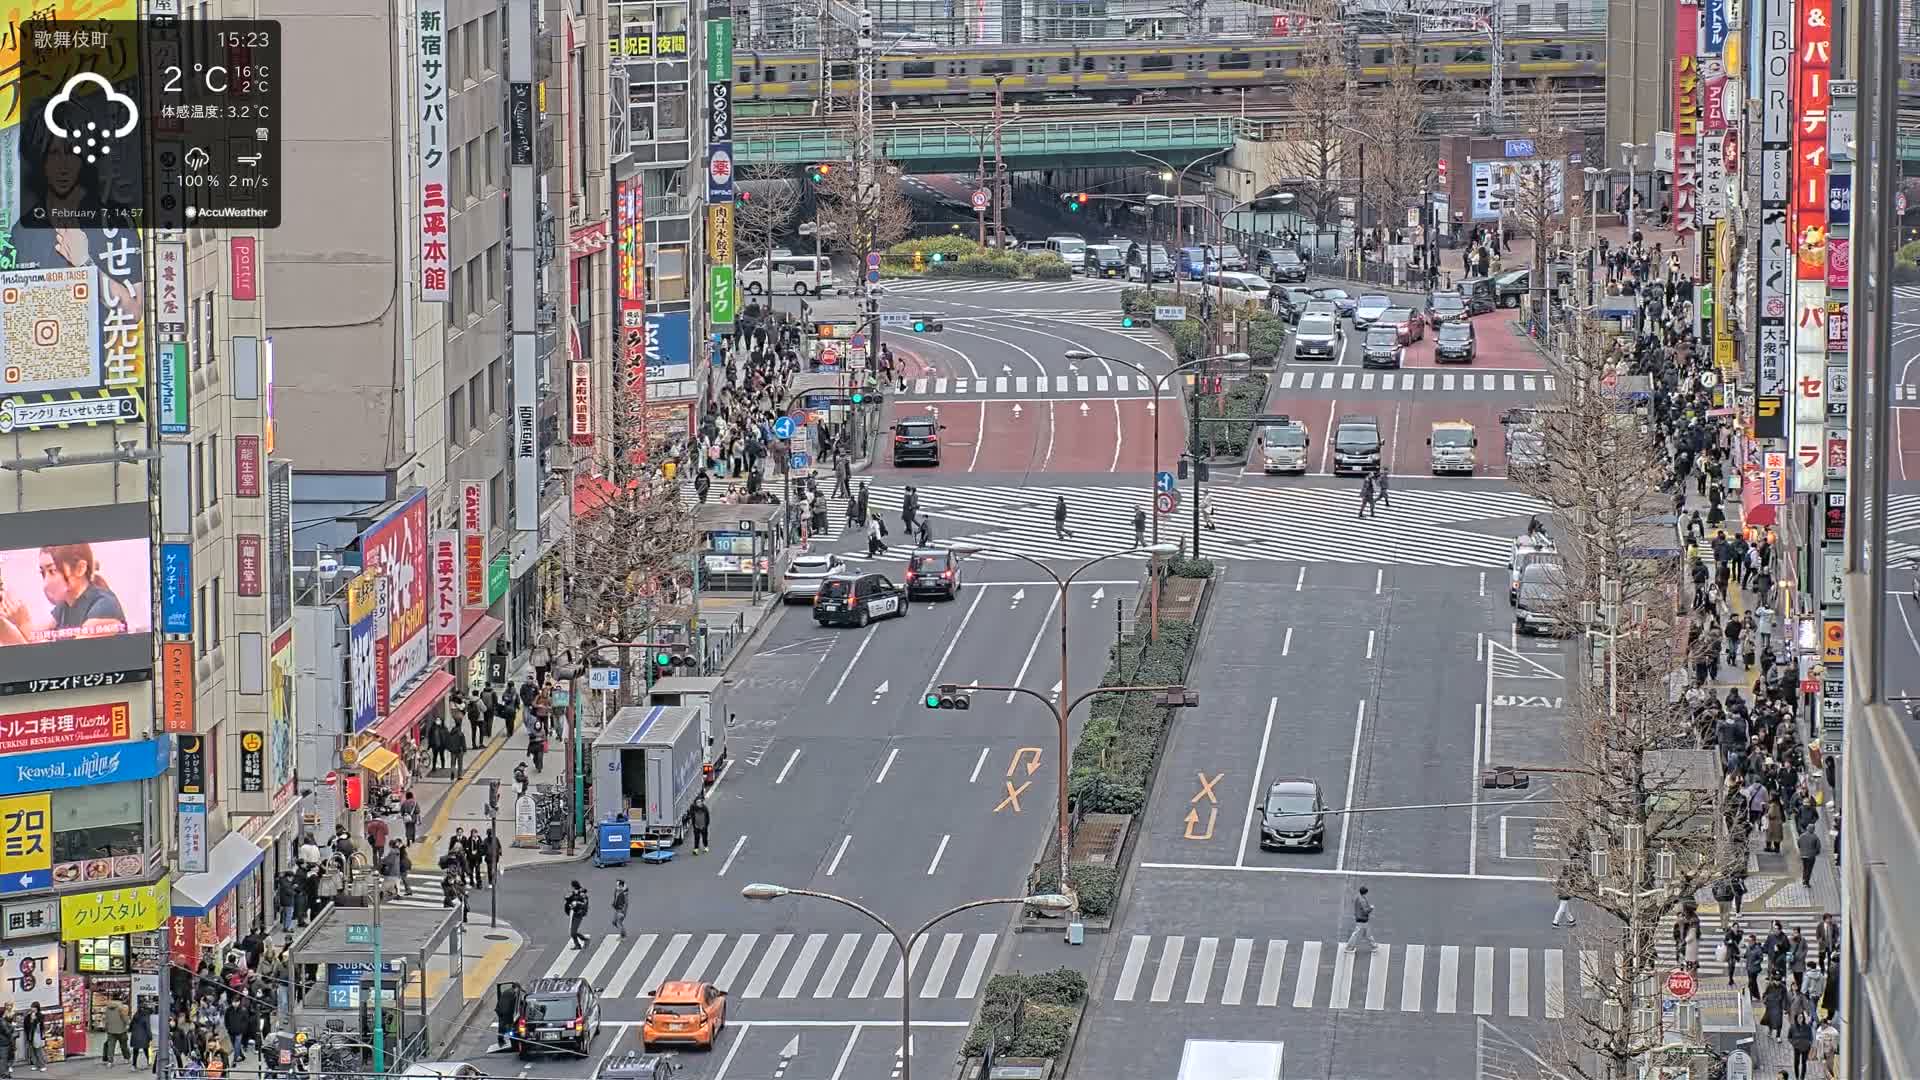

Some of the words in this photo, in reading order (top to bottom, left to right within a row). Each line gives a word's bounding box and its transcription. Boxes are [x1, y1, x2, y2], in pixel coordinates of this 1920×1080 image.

[624, 36, 652, 54] 祝日
[657, 35, 685, 53] 夜間
[421, 10, 443, 169] 新宿サンパーク
[1680, 56, 1696, 135] パチンコ
[713, 84, 728, 137] もつなべ
[1709, 86, 1721, 119] アコム
[712, 160, 730, 176] 薬
[1679, 145, 1696, 232] エスパス
[424, 184, 446, 290] 三平本館
[714, 206, 729, 261] 肉汁水餃子
[1, 273, 45, 285] Instagram
[715, 275, 728, 311] レイク
[163, 323, 181, 333] 3F
[1763, 329, 1776, 381] 大衆酒場
[162, 353, 174, 412] FamilyMart
[1799, 307, 1825, 468] パセラ
[18, 406, 54, 420] テンクリ
[58, 400, 117, 417] たいせい先生
[519, 406, 532, 458] HOMEGAME
[465, 486, 476, 530] GAME
[717, 540, 730, 550] 10
[439, 541, 454, 627] 三平ストア
[29, 672, 125, 693] リアエイドビジョン
[114, 709, 125, 736] 5F
[30, 733, 74, 747] RESTAURANT
[5, 810, 44, 834] プロ
[5, 837, 44, 856] ミス
[9, 910, 44, 930] 囲碁
[74, 902, 147, 926] クリスタル
[337, 962, 389, 970] SUBNAE
[332, 990, 346, 1003] 12
